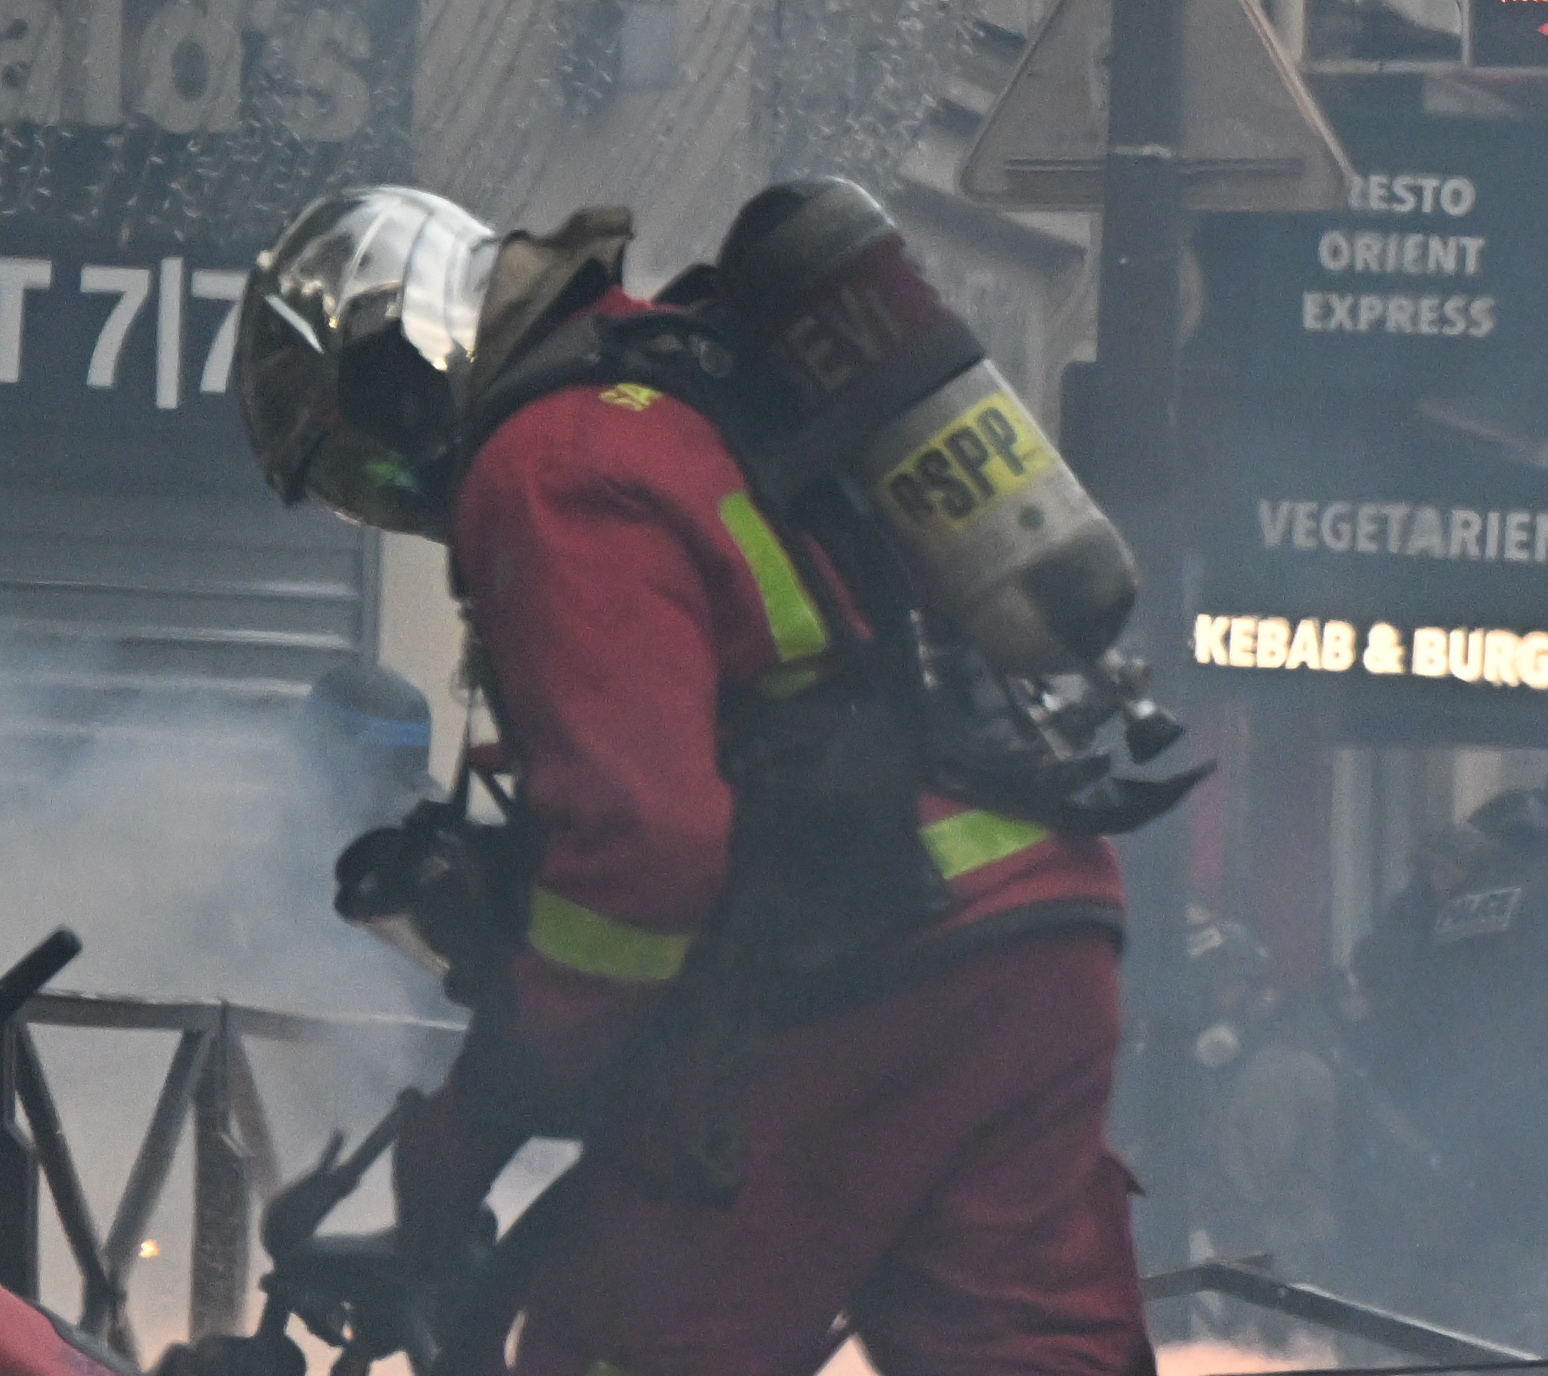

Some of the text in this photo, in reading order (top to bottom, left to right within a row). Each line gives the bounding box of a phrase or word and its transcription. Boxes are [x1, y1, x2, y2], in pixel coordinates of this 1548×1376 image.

[1318, 228, 1486, 278] ORIENT
[1302, 290, 1497, 340] EXPRESS
[887, 406, 1029, 522] BSPP
[1194, 613, 1356, 672] KEBAB
[1362, 622, 1405, 676] &
